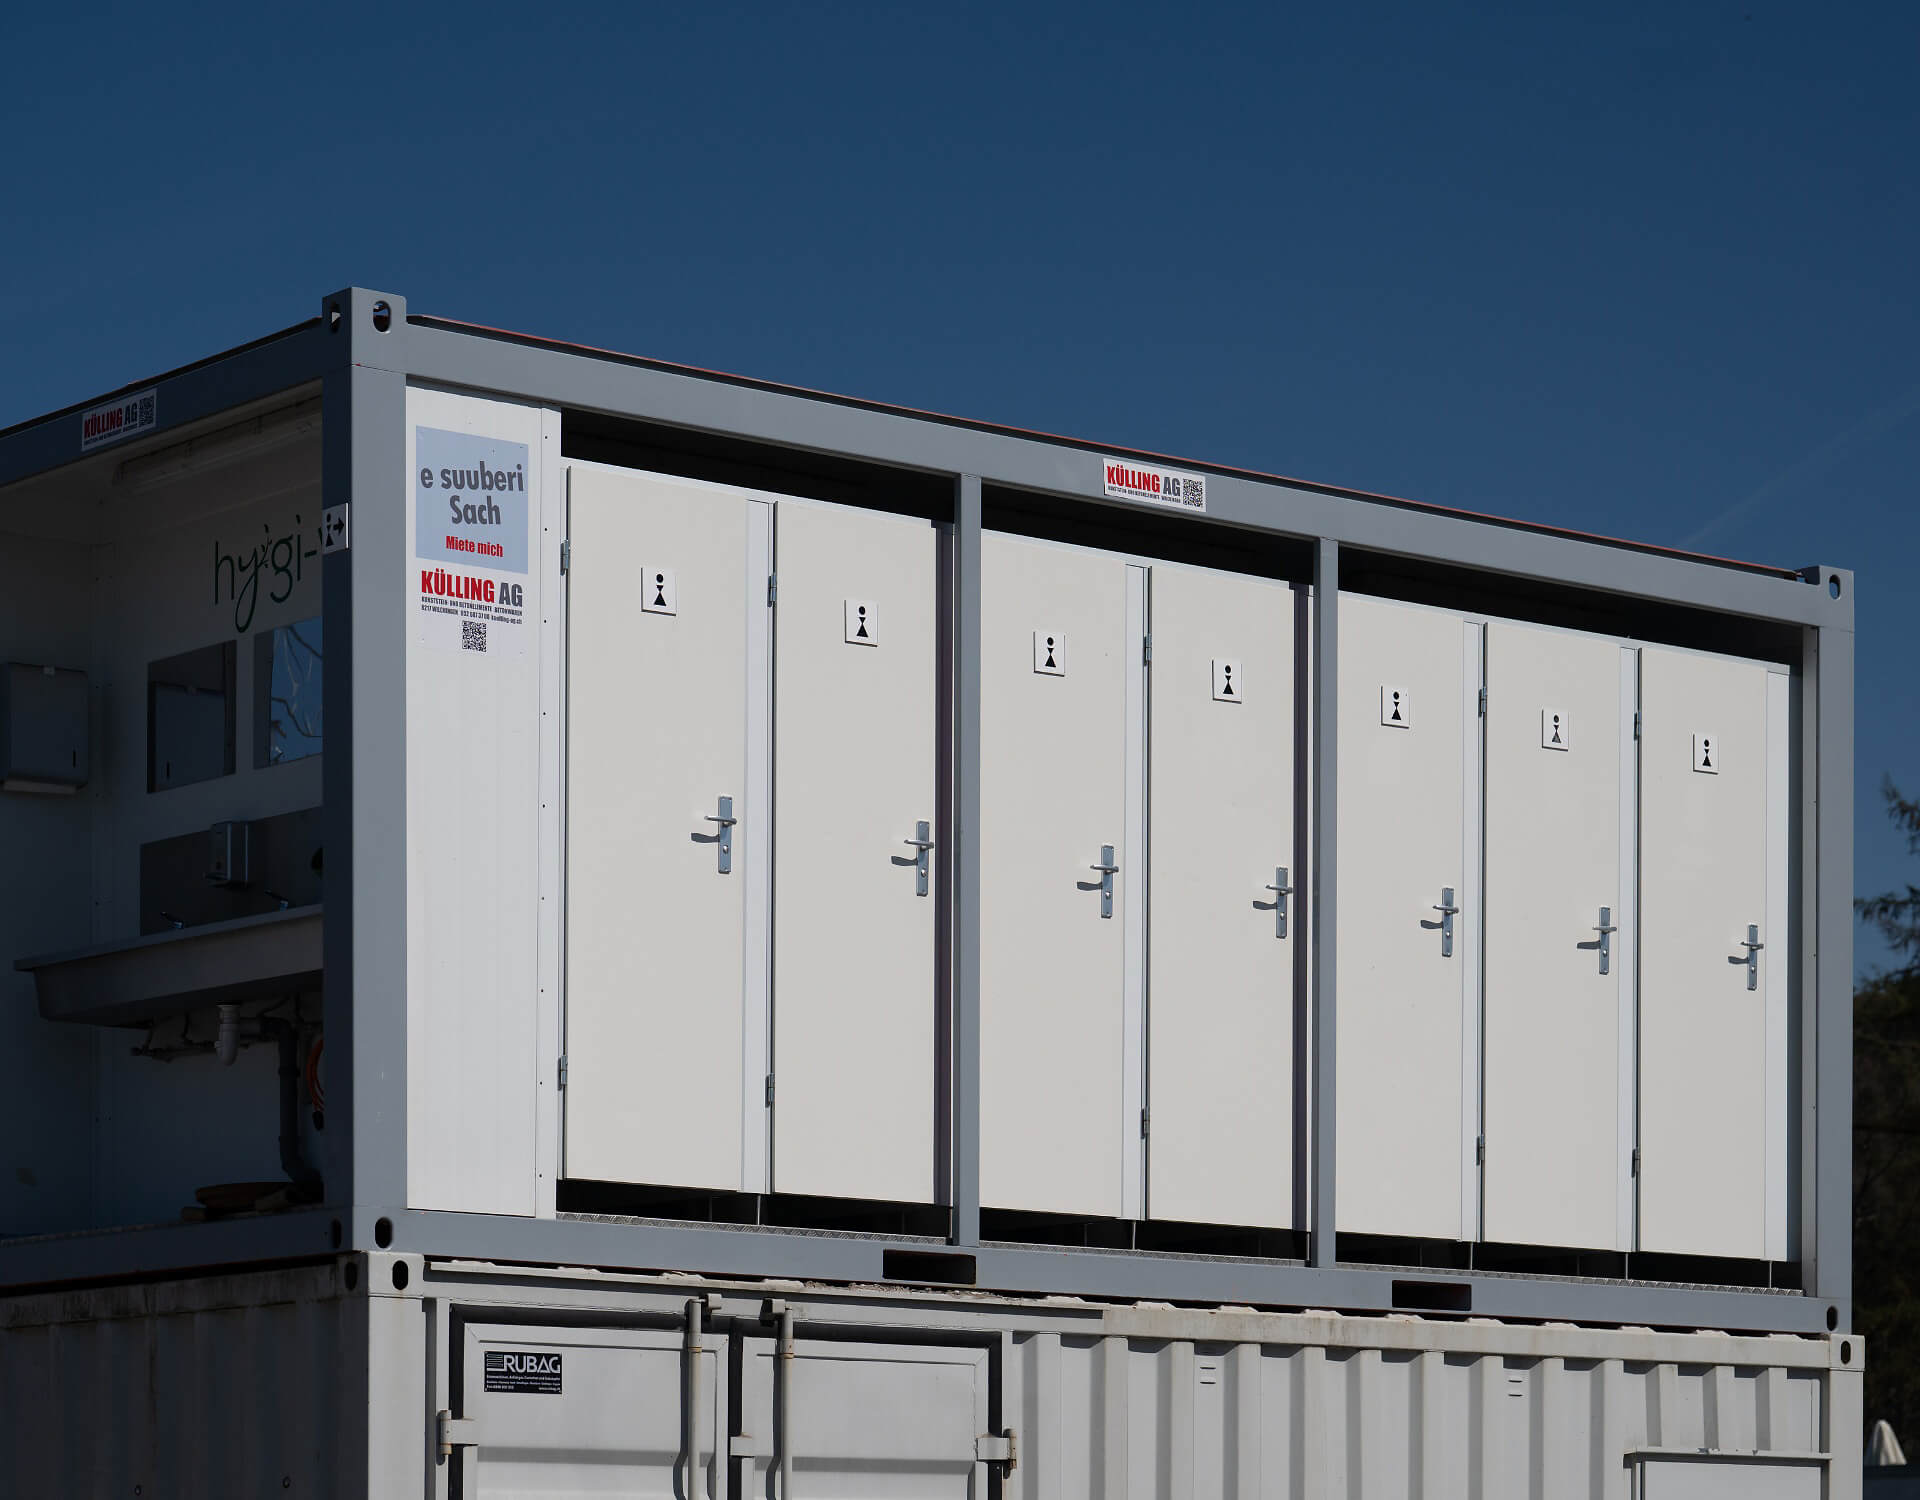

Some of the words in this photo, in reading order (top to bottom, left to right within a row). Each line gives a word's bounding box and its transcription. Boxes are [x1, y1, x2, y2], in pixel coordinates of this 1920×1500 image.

[84, 407, 123, 440] KÜLLING
[125, 402, 138, 425] AG
[420, 467, 434, 489] e
[440, 460, 524, 492] suuberi
[1106, 464, 1161, 493] KÜLLING
[1162, 476, 1181, 497] AG
[449, 494, 501, 525] Sach
[445, 535, 475, 553] Miete
[477, 542, 504, 558] mich
[214, 514, 323, 633] hygi-
[421, 567, 495, 604] KÜLLING
[498, 582, 523, 608] AG
[503, 1354, 561, 1374] RUBAG
